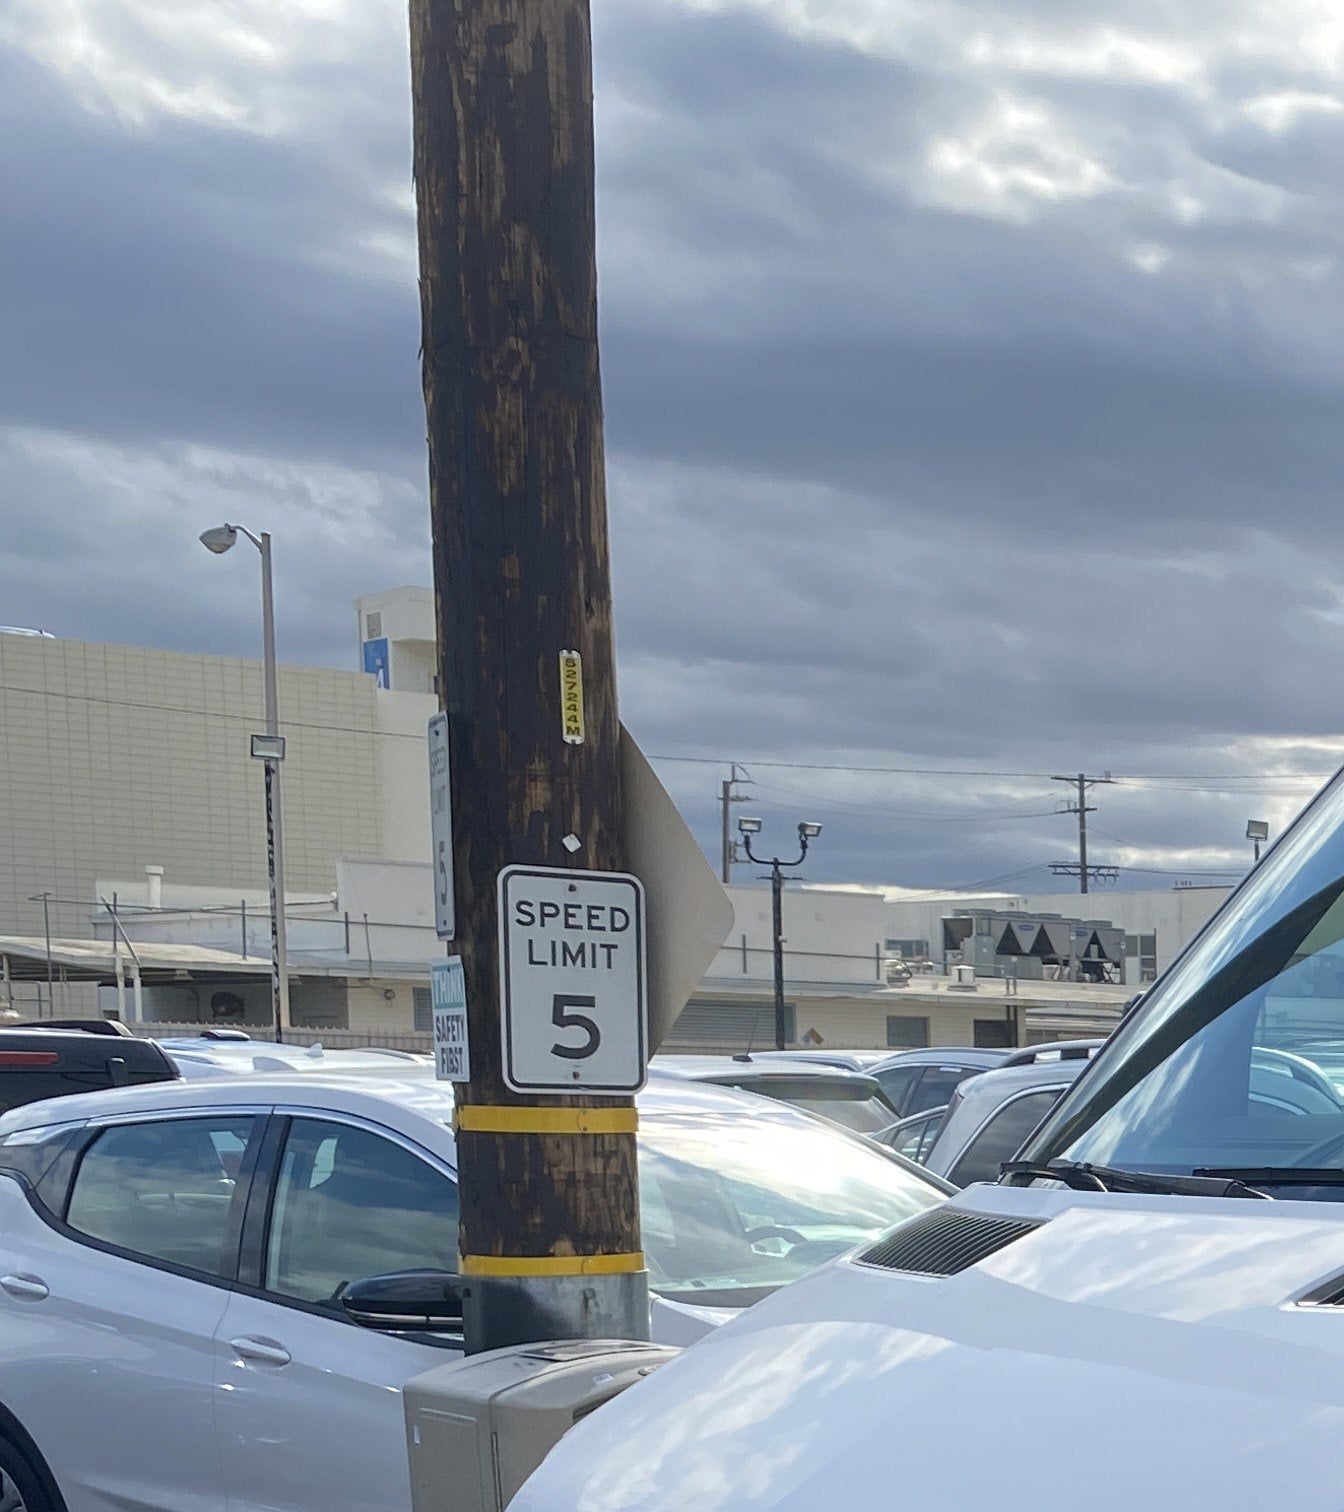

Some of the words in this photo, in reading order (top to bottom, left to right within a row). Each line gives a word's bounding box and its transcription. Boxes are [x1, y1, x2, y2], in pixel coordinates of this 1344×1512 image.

[438, 840, 448, 907] 5
[515, 899, 630, 933] SPEED
[528, 938, 618, 970] LIMIT
[435, 1014, 465, 1043] SAFETY
[550, 993, 602, 1060] 5
[441, 1046, 463, 1074] FIRST
